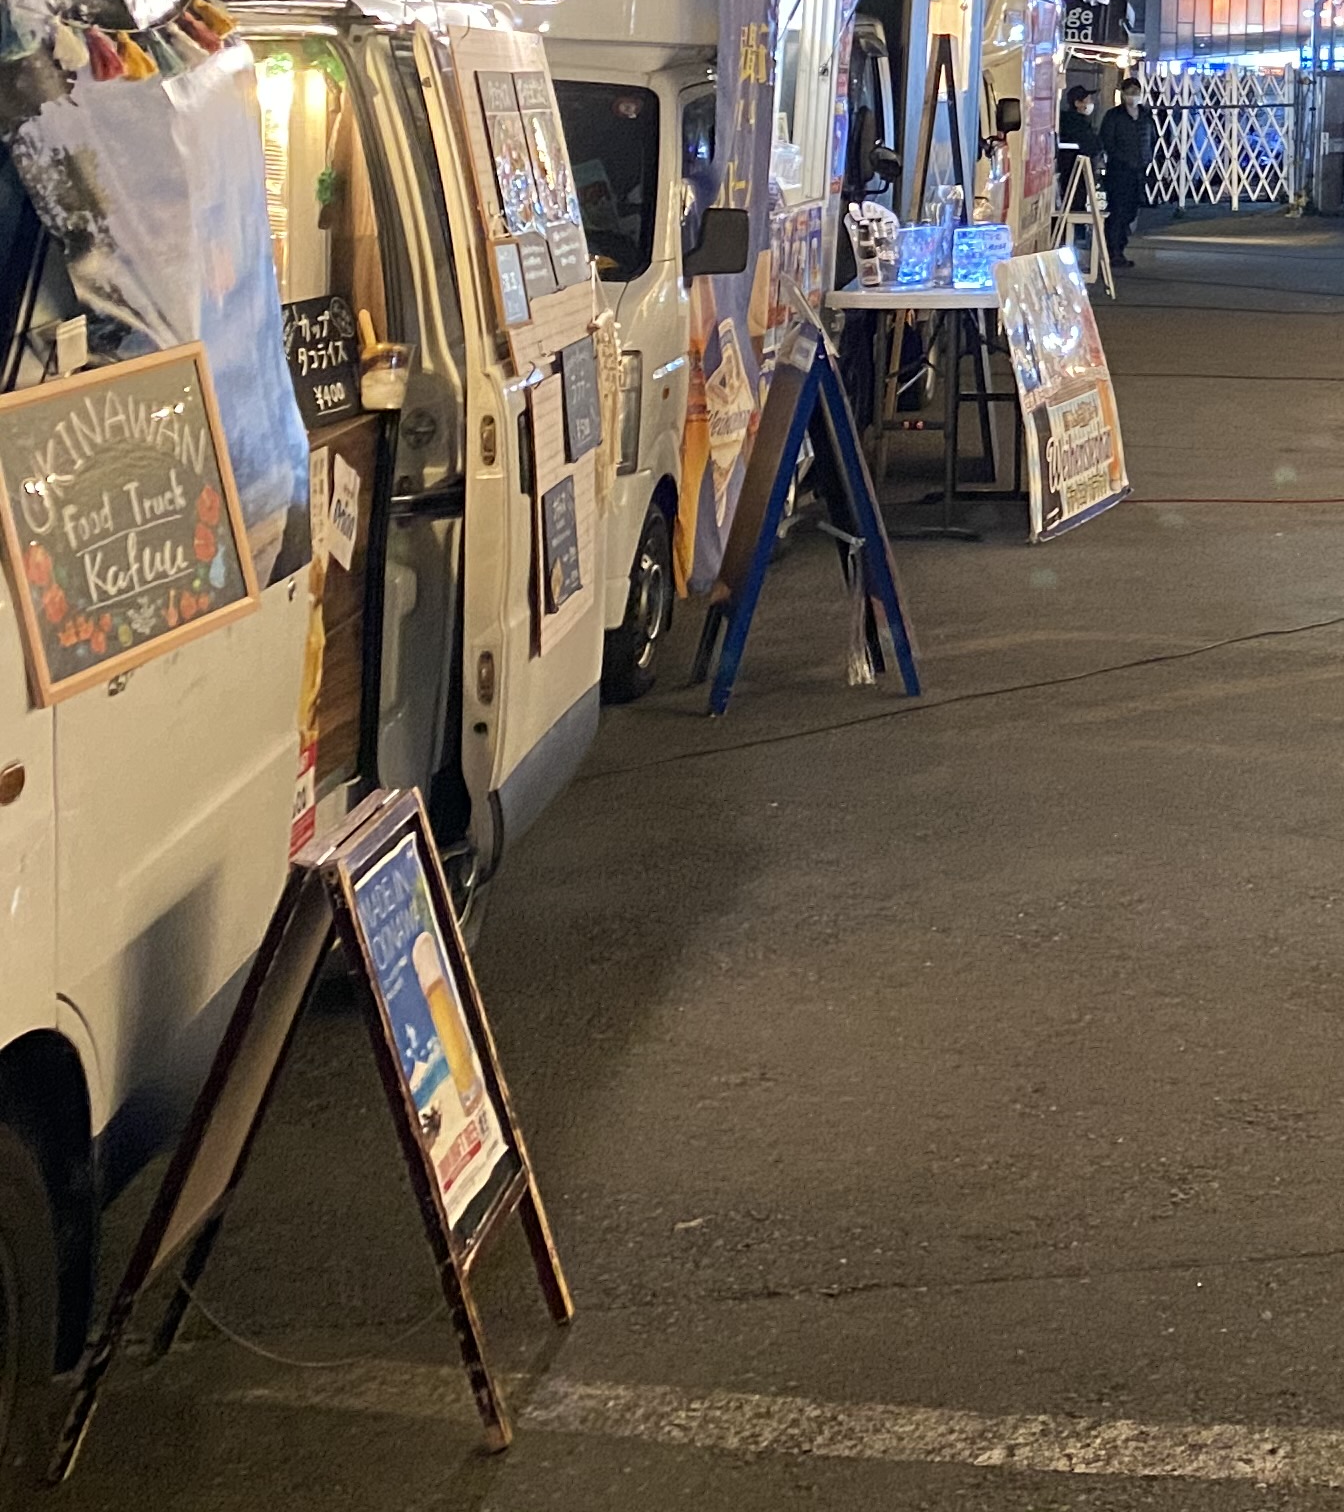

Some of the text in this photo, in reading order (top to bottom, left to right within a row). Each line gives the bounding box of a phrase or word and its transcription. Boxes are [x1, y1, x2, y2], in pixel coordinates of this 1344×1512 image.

[297, 341, 349, 377] タコライス
[312, 382, 346, 411] ¥400
[20, 391, 207, 534] OKINAWAN
[61, 468, 187, 550] Food Truck
